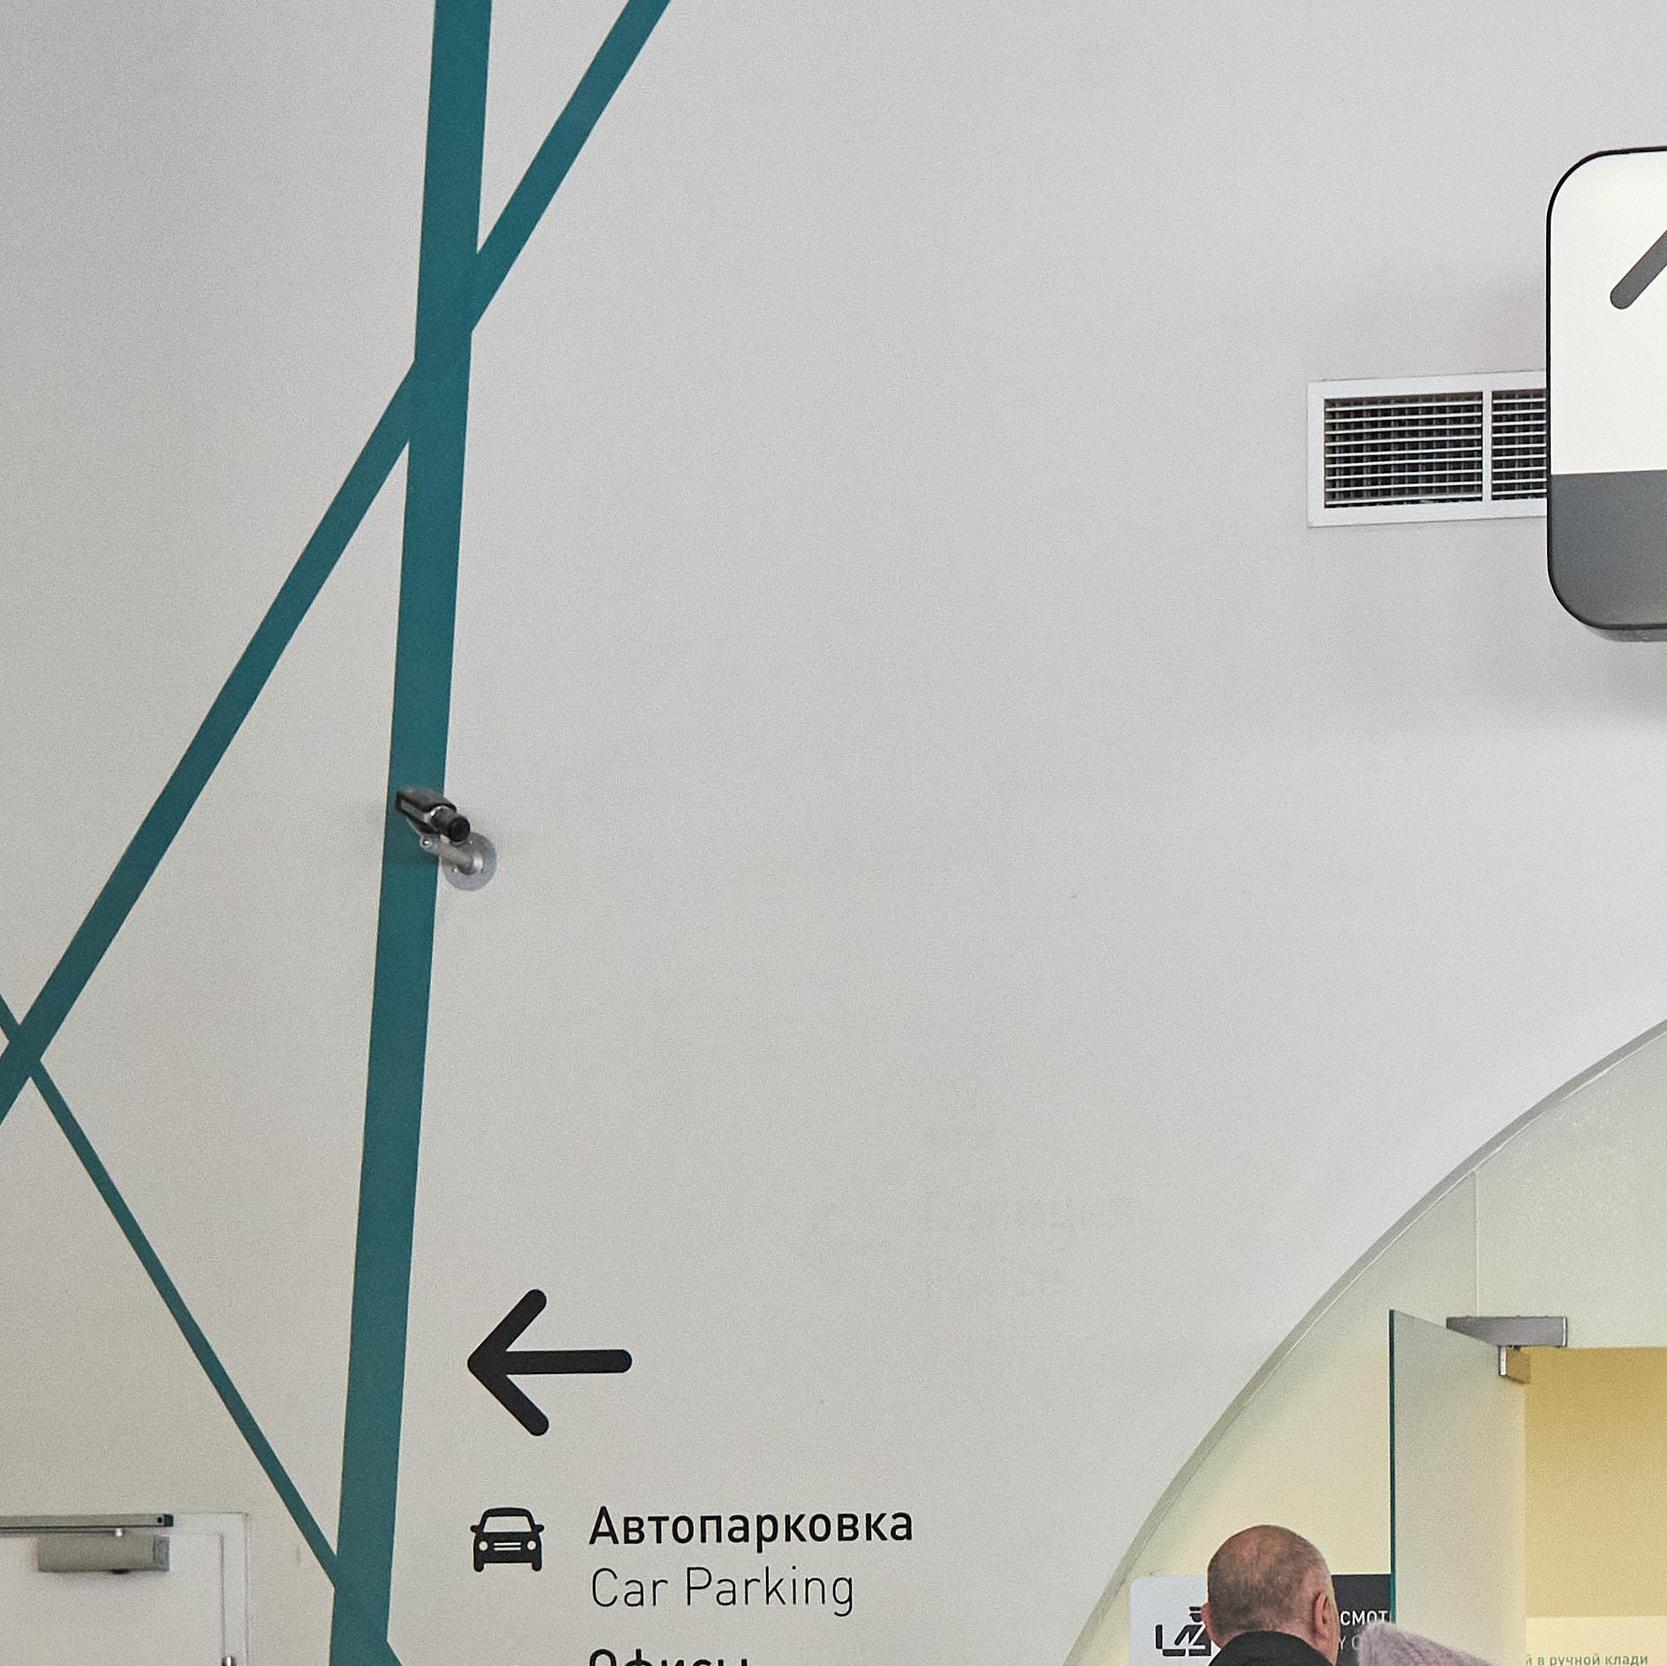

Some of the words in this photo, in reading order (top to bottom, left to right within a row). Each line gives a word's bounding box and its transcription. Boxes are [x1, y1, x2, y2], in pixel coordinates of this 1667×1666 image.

[589, 1505, 913, 1553] Автопарковка
[591, 1568, 668, 1608] Car
[685, 1565, 854, 1617] Parking
[1341, 1610, 1388, 1625] СМОТ
[1605, 1656, 1648, 1666] клади
